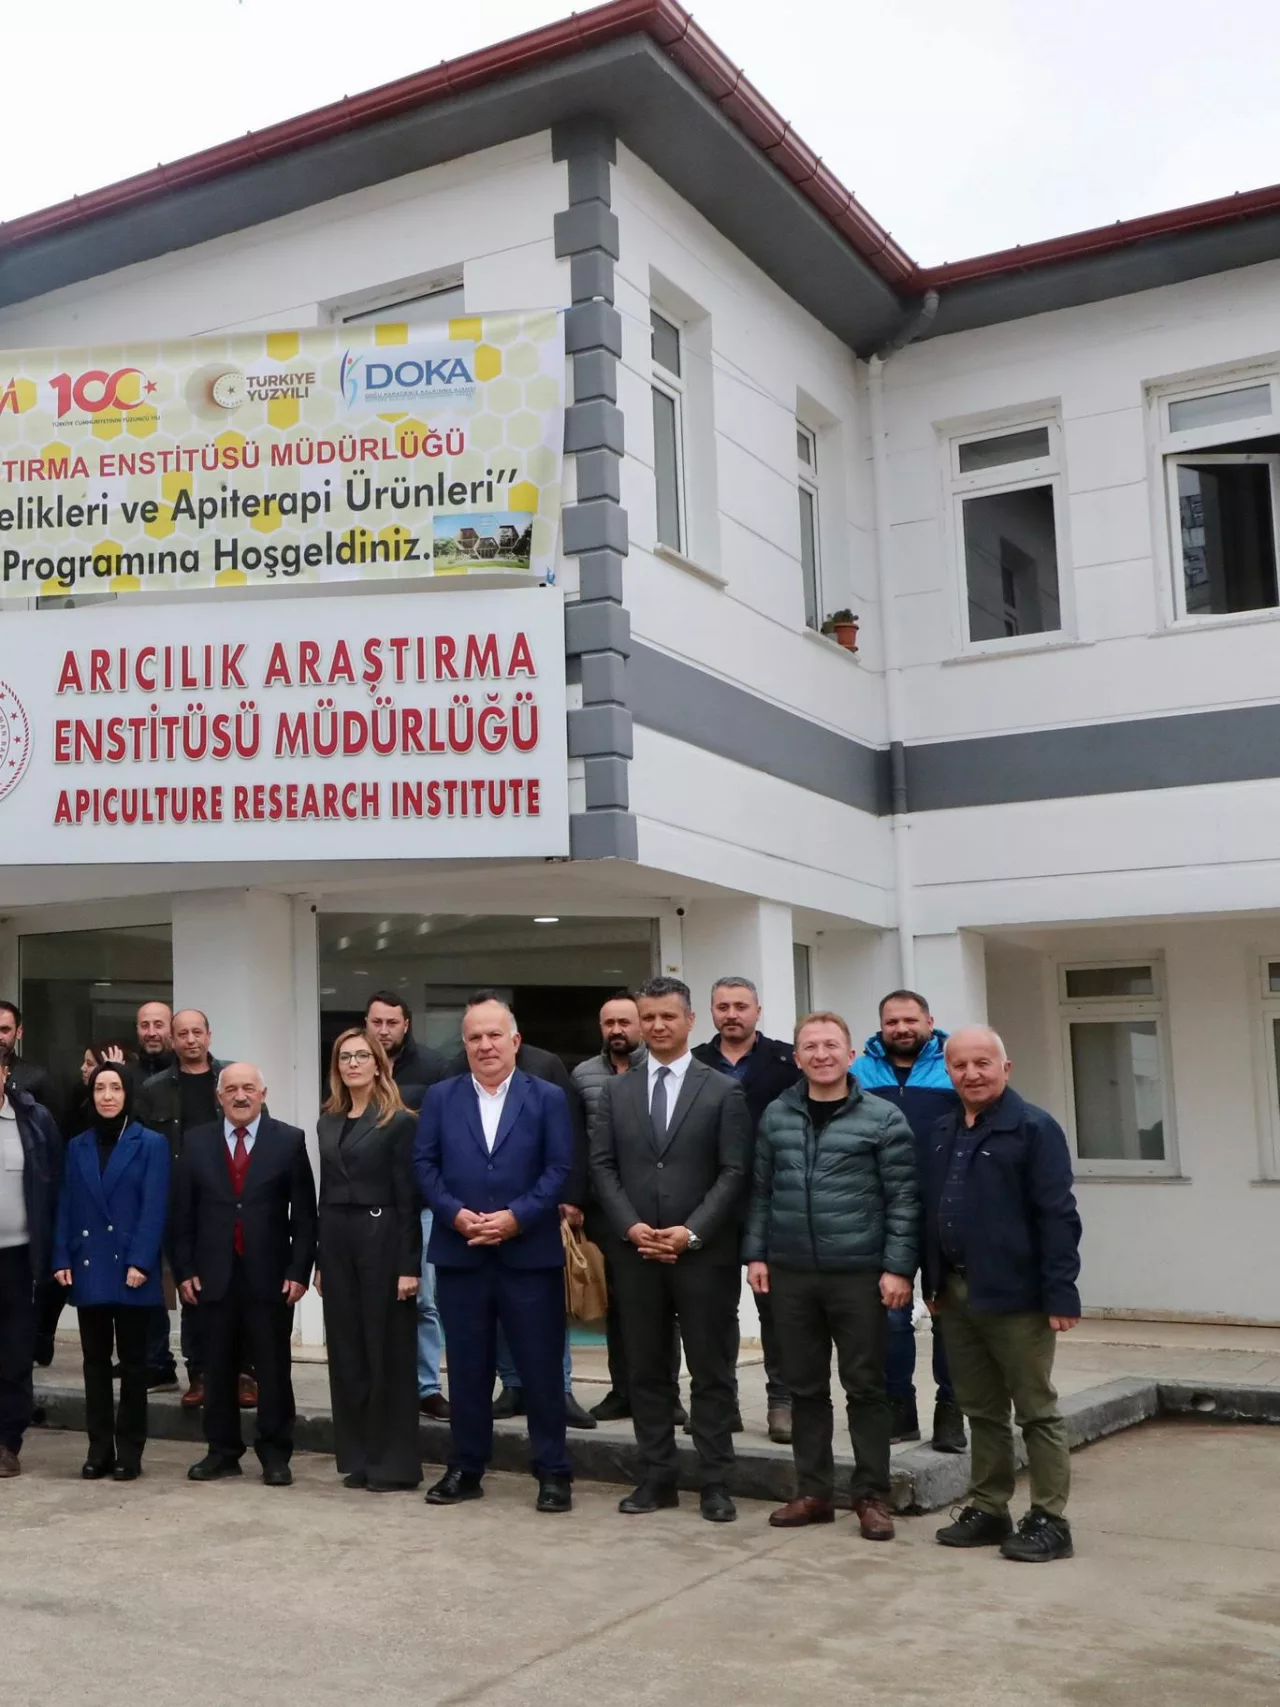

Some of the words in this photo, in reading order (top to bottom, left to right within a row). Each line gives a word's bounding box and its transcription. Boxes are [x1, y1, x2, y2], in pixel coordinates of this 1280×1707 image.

[365, 358, 474, 389] DOKA
[99, 440, 260, 475] ENSTİTÜSÜ
[271, 428, 466, 466] MÜDÜRLÜĞÜ
[120, 501, 160, 525] ve
[170, 479, 332, 529] Apiterapi
[3, 550, 201, 588] Programına
[214, 530, 432, 578] Hoşgeldiniz.
[56, 643, 248, 694] ARICILIK
[263, 632, 538, 695] ARAŞTIRMA
[54, 701, 261, 763] ENSTİTÜSÜ
[275, 692, 539, 758] MÜDÜRLÜĞÜ
[54, 785, 224, 825] APICULTURE
[233, 781, 380, 821] RESEARCH
[391, 779, 540, 818] INSTITUTE
